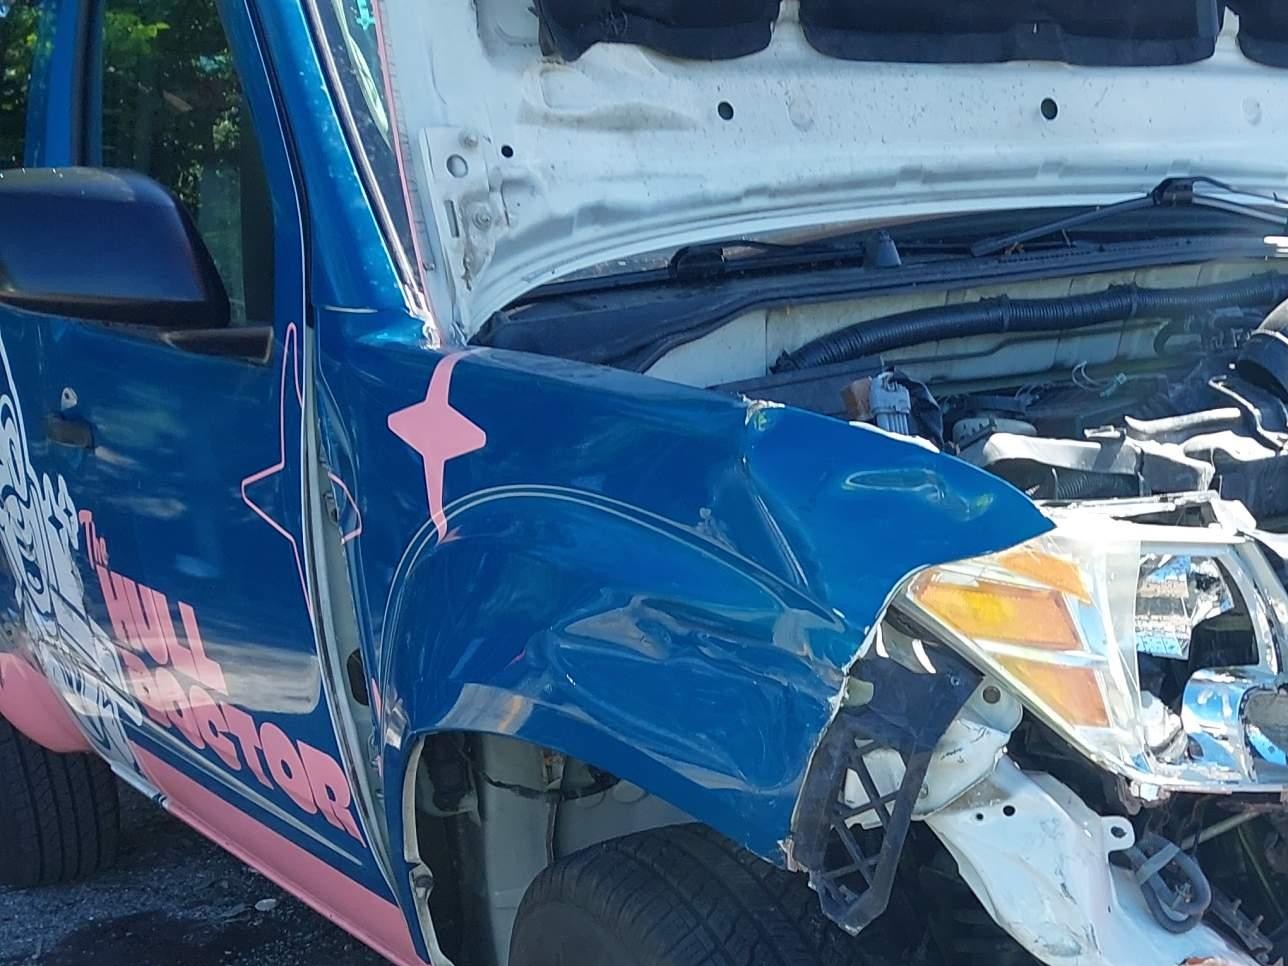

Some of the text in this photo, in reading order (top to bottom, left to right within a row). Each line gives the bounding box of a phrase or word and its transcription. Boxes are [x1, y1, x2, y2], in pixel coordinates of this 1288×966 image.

[78, 509, 109, 570] The
[95, 563, 229, 697] HULL
[118, 648, 367, 849] DOCTOR
